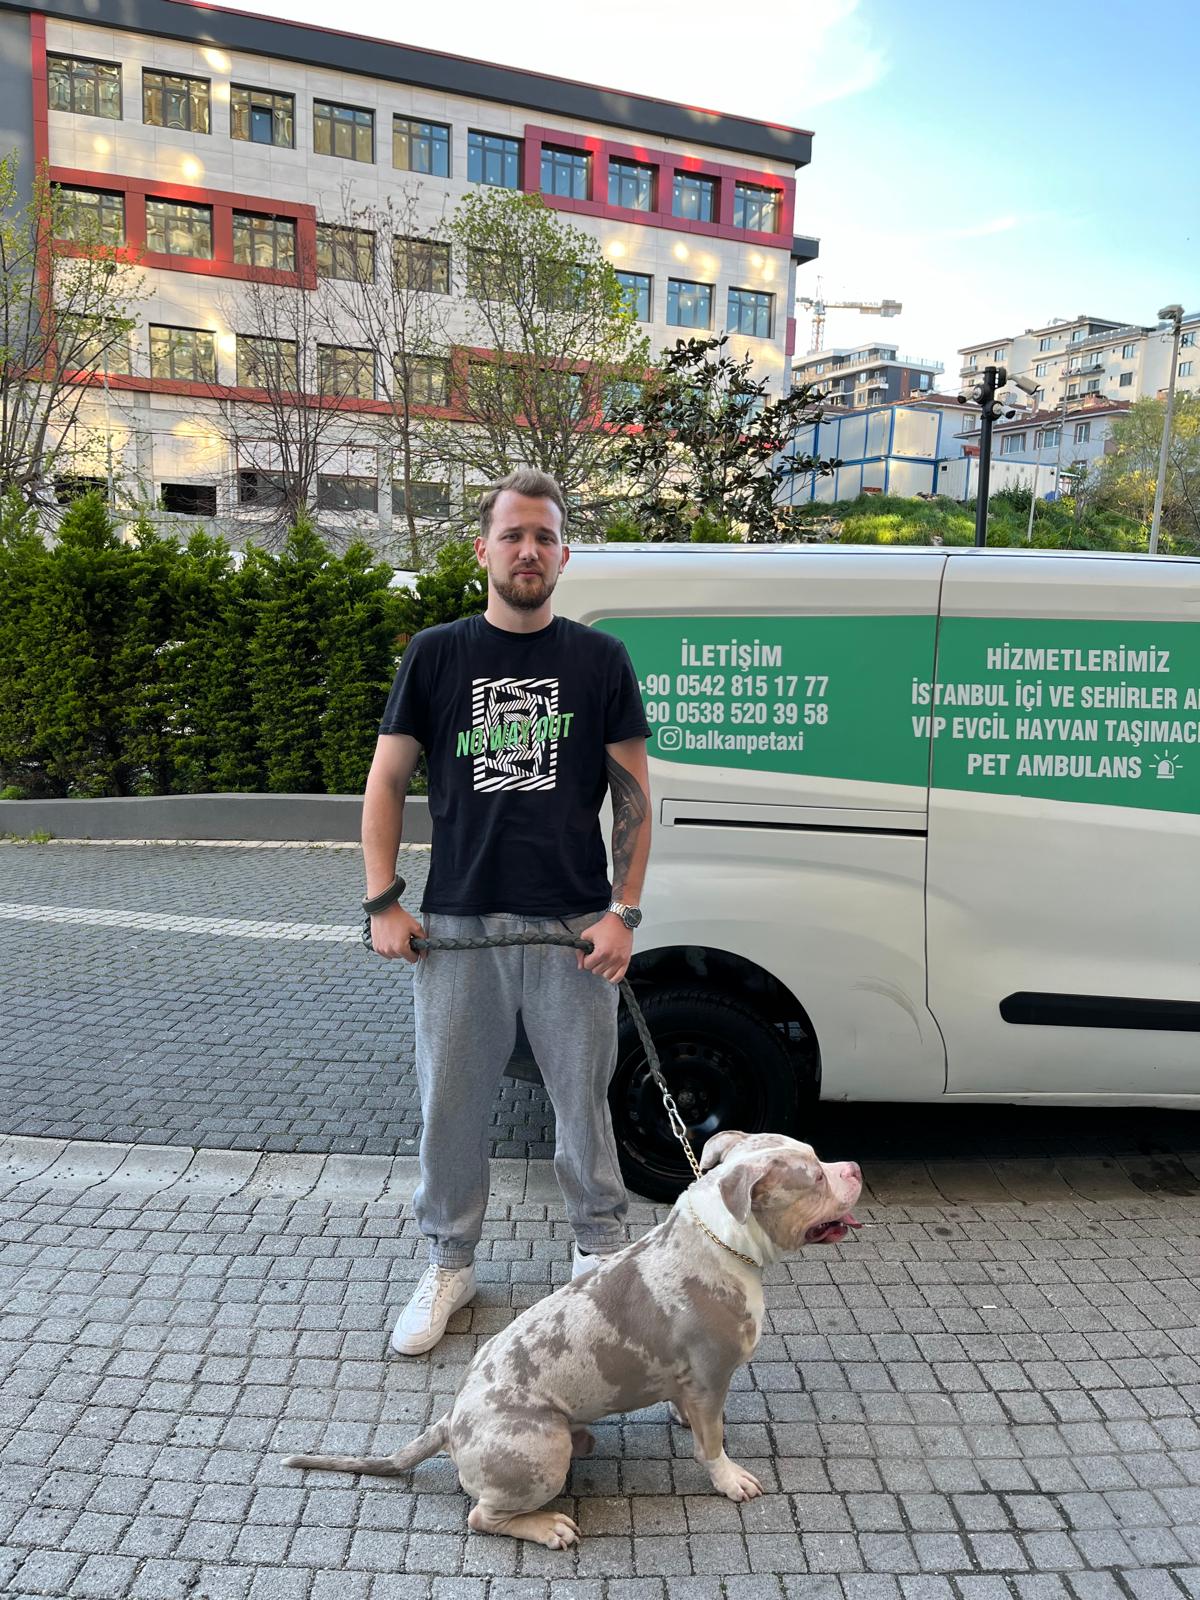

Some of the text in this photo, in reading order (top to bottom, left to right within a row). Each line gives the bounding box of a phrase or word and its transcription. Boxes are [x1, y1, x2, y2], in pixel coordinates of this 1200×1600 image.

[681, 638, 782, 672] İLETİŞİM
[987, 642, 1170, 673] HİZMETLERİMİZ
[676, 674, 725, 697] 0542
[731, 675, 768, 697] 815
[774, 676, 798, 697] 17
[804, 676, 829, 697] 77
[911, 677, 1009, 707] İSTANBUL
[1015, 679, 1043, 712] İÇİ
[1049, 685, 1075, 708] VE
[1080, 681, 1178, 710] SEHİRLER
[676, 701, 724, 724] 0538
[730, 702, 767, 725] 520
[773, 703, 798, 725] 39
[804, 703, 829, 725] 58
[911, 716, 946, 739] VIP
[952, 712, 1010, 740] EVCİL
[1015, 719, 1098, 742] HAYVAN
[456, 712, 574, 758] NO WAY OUT
[685, 730, 804, 755] balkanpetaxi
[967, 753, 1142, 779] PET AMBULANS
